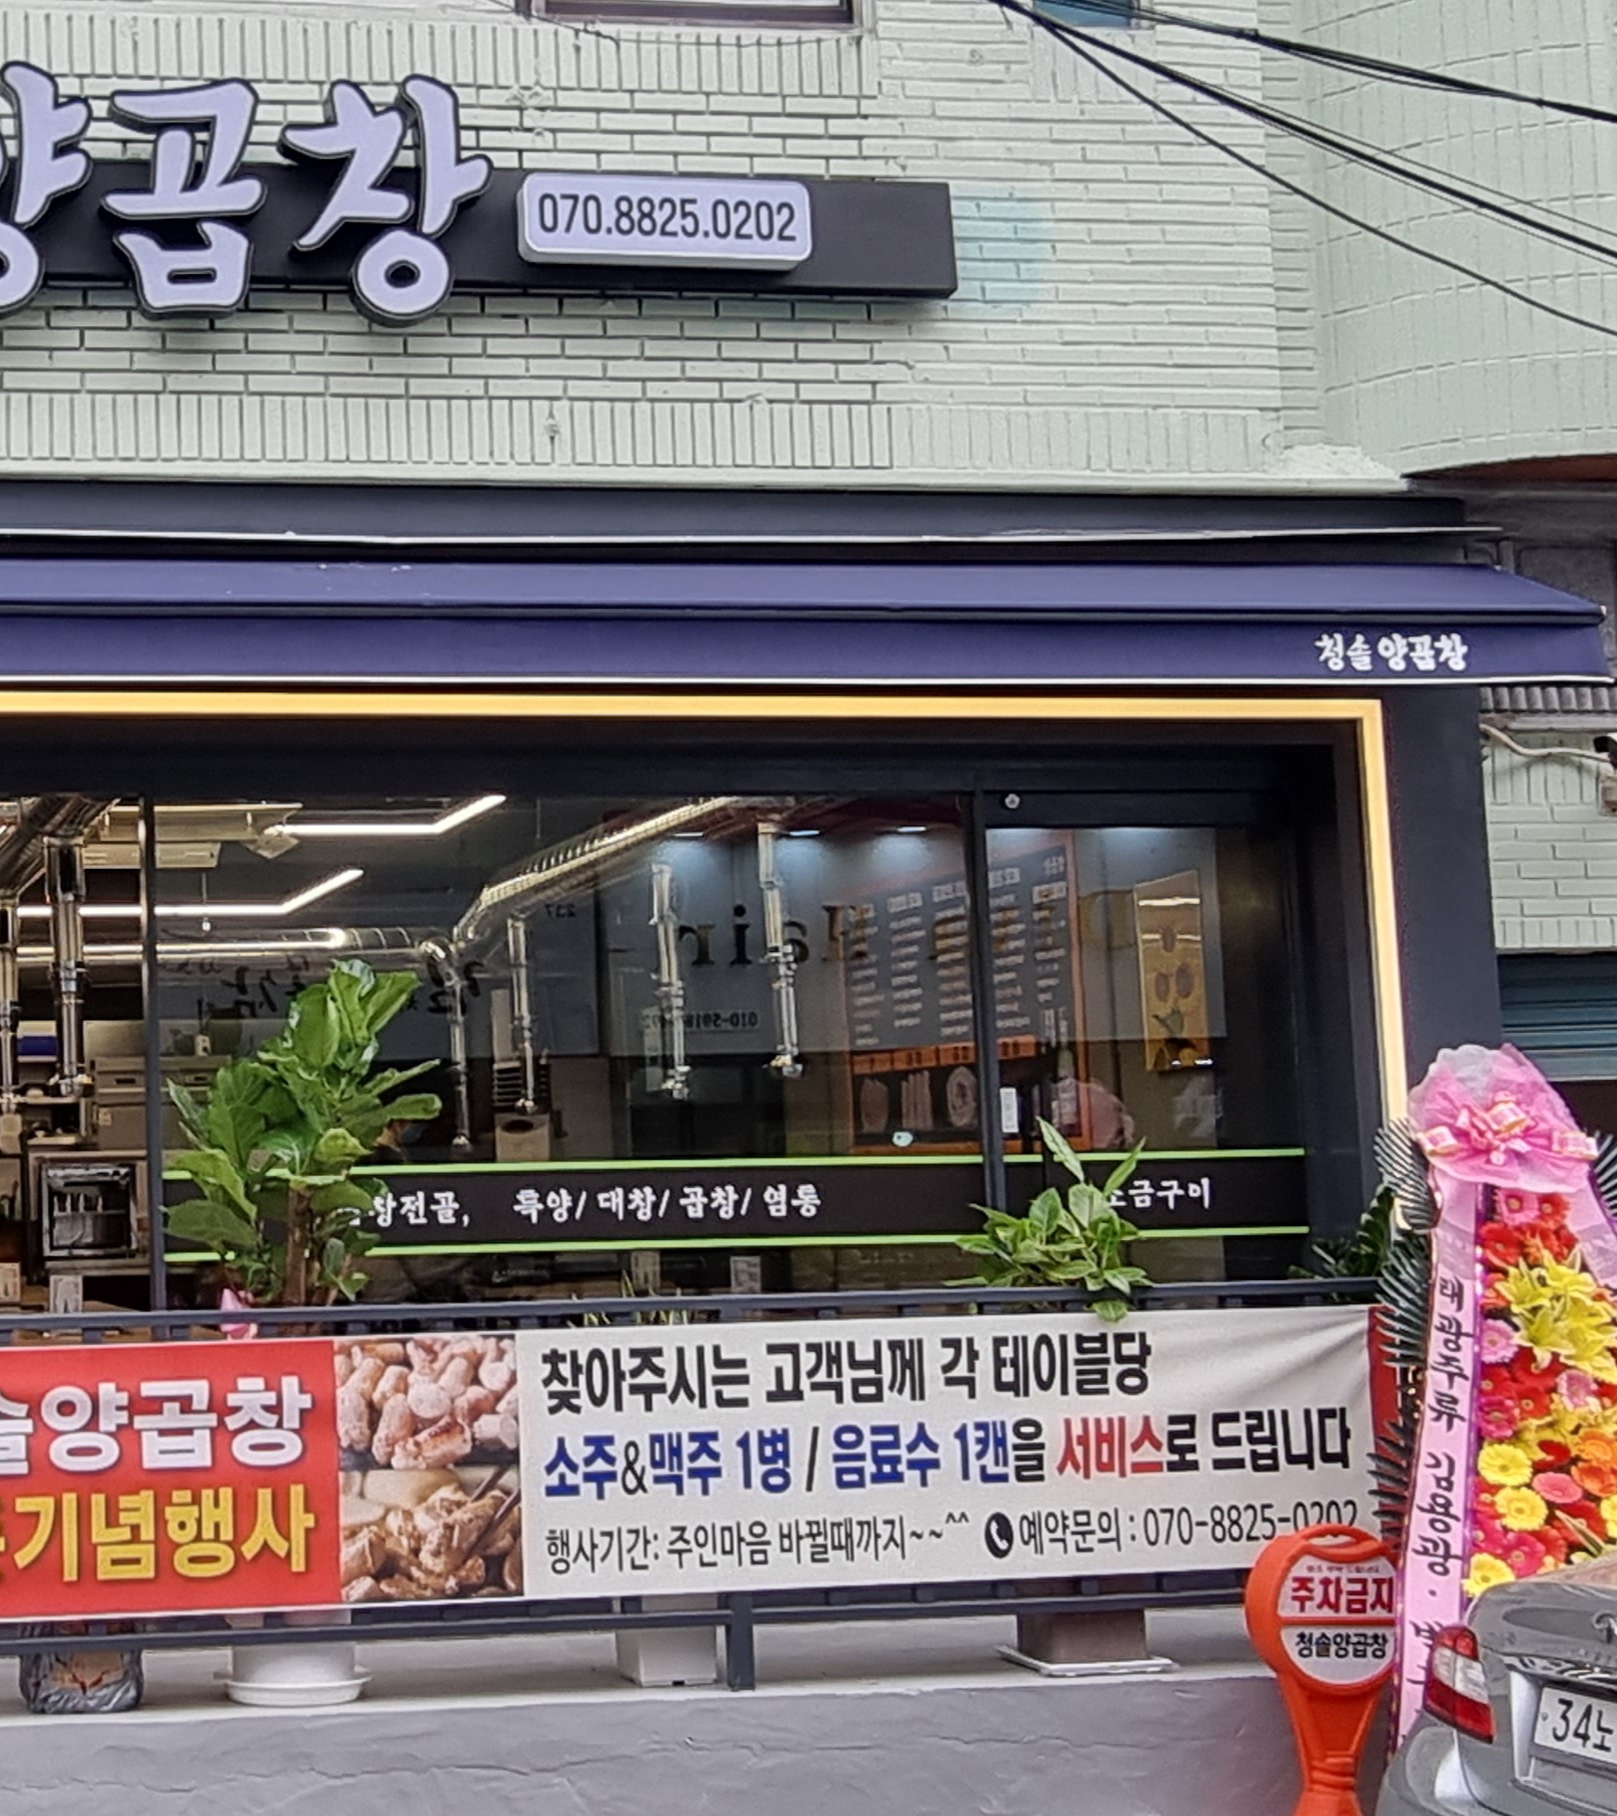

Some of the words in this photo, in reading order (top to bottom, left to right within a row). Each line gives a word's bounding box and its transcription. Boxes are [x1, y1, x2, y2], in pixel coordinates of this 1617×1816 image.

[536, 190, 798, 244] 070.8825.0202
[1314, 632, 1373, 672] 청솔
[1377, 632, 1469, 672] 양곱창
[763, 1183, 822, 1218] 염통
[541, 1343, 752, 1416] 찾아주시는
[764, 1337, 927, 1405] 고객님께
[939, 1336, 980, 1400] 각
[991, 1330, 1153, 1399] 테이블당
[543, 1429, 724, 1500] 소주&맥주
[735, 1427, 793, 1494] 1병
[831, 1421, 942, 1490] 음료수
[953, 1416, 1047, 1484] 1캔을
[1056, 1413, 1201, 1481] 서비스로
[1211, 1405, 1353, 1474] 드립니다
[545, 1524, 660, 1576] 행사기간:
[667, 1519, 772, 1570] 주인마음
[1291, 1575, 1394, 1614] 주차금지
[1295, 1631, 1389, 1659] 청솔양곱창
[1552, 1697, 1614, 1752] 34노
